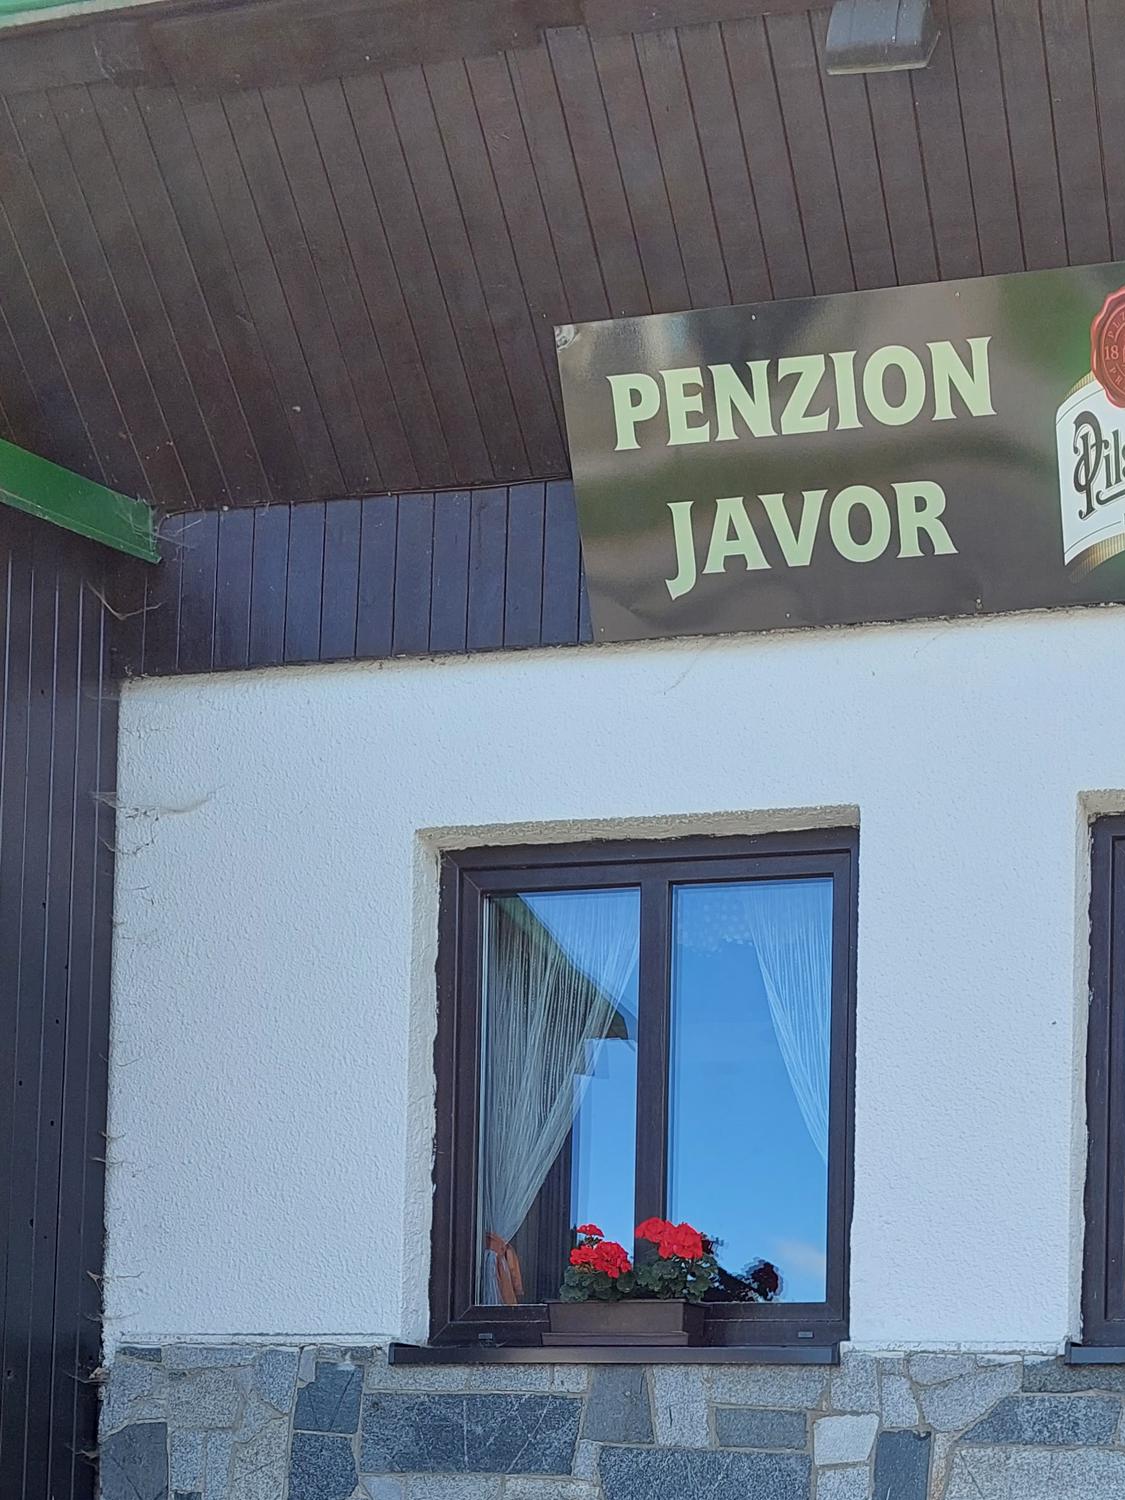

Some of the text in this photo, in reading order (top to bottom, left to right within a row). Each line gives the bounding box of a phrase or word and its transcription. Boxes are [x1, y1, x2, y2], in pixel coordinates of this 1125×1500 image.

[606, 335, 998, 451] PENZION
[1104, 344, 1119, 361] 18
[665, 480, 959, 600] JAVOR
